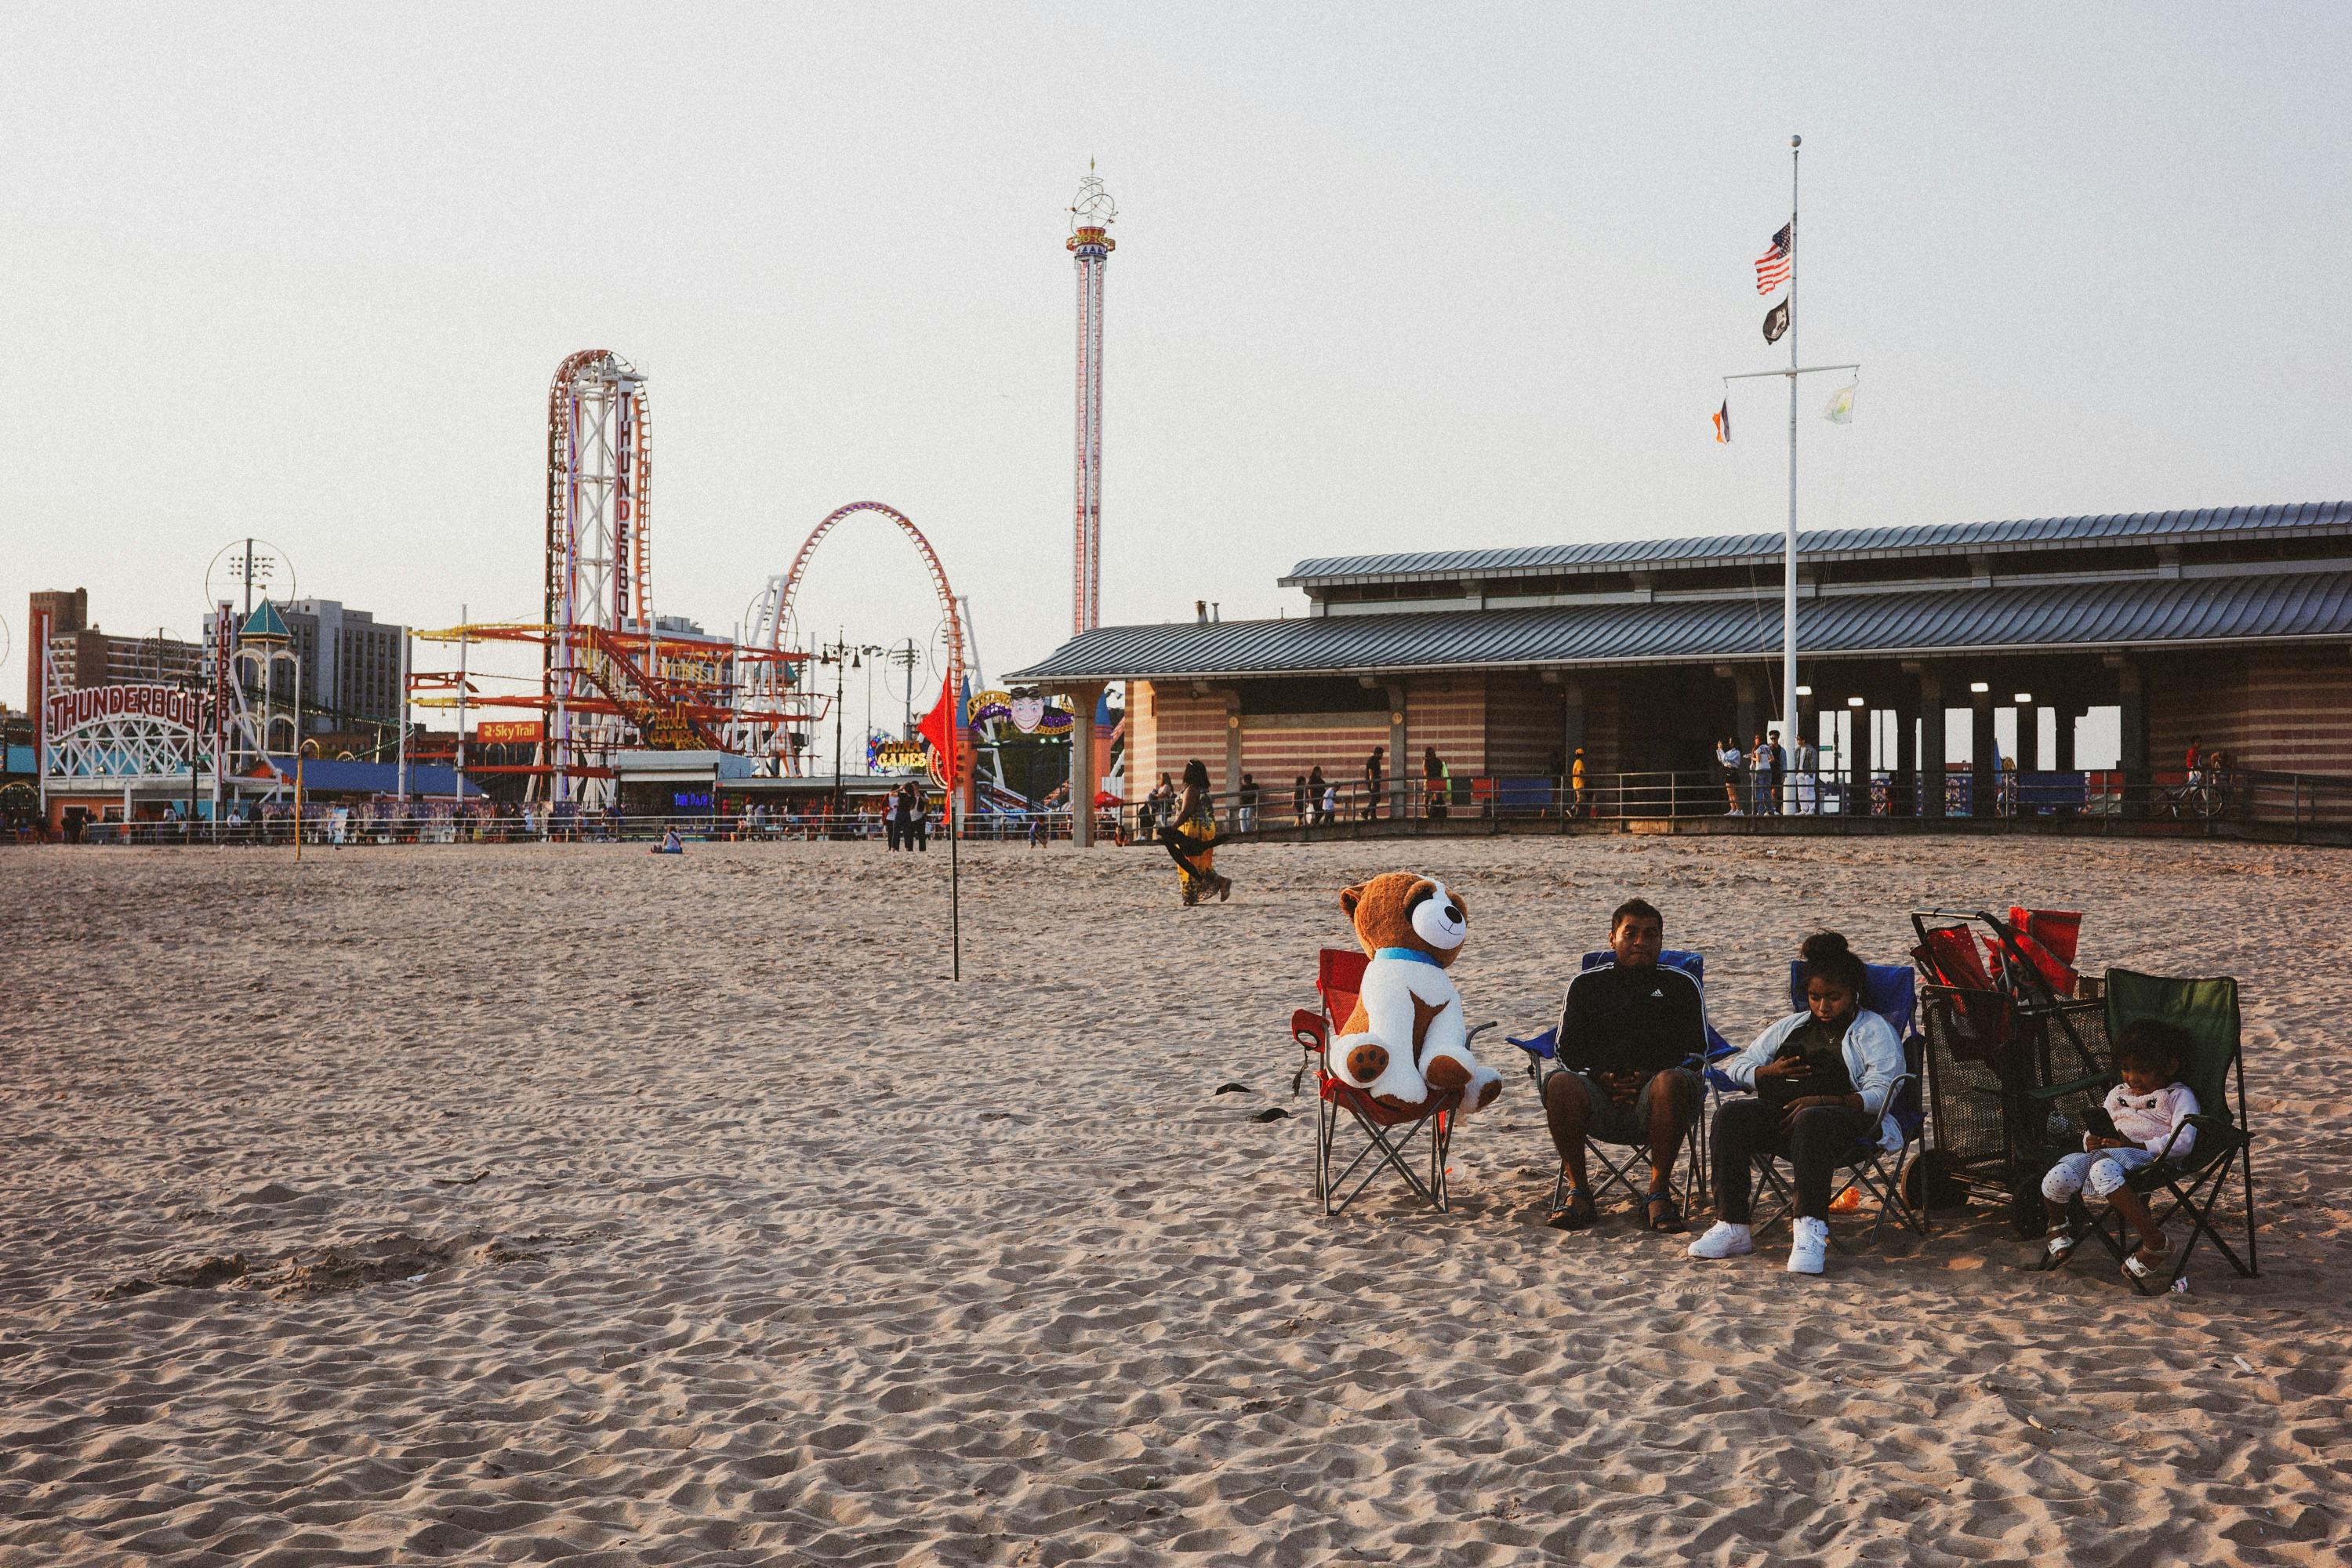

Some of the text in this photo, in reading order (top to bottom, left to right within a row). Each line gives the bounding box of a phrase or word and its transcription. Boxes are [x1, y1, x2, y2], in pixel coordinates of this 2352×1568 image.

[495, 724, 514, 740] Sky
[514, 723, 535, 736] Trail
[884, 739, 922, 753] LUNA
[877, 752, 927, 768] GAMES
